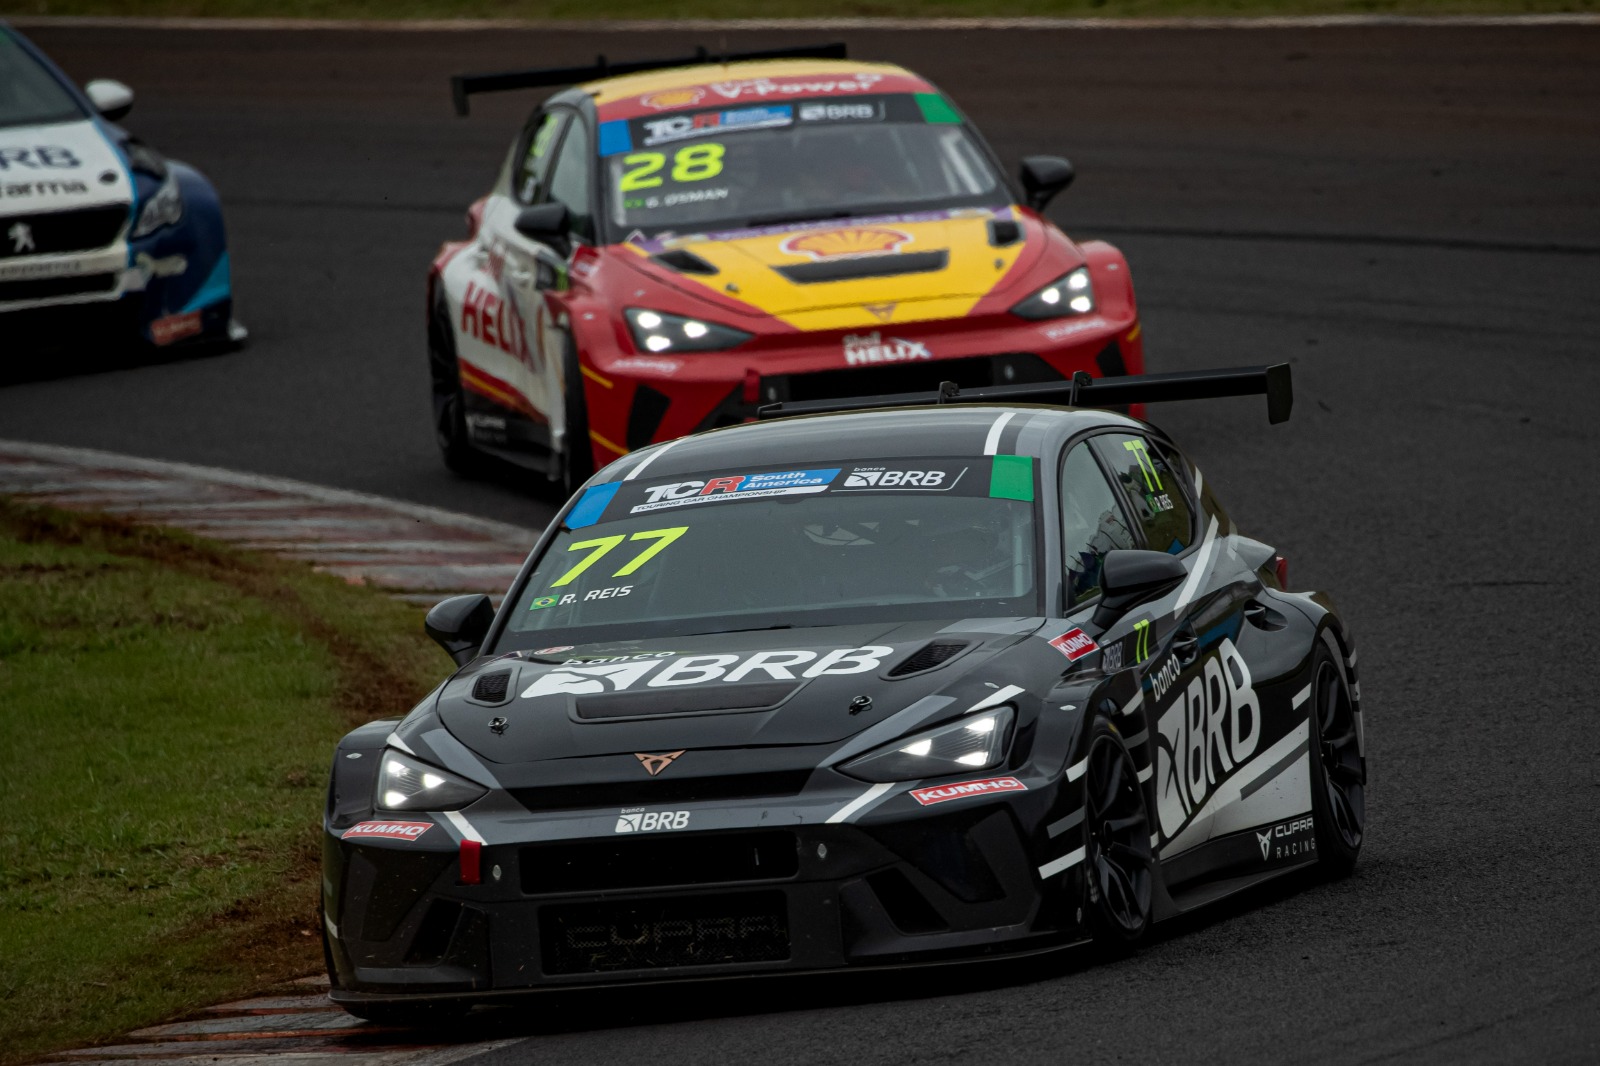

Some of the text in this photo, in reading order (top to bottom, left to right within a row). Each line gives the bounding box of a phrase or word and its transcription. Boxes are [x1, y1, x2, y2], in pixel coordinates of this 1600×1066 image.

[620, 142, 726, 192] 28
[844, 337, 931, 366] HELIX
[751, 471, 806, 481] South
[1122, 439, 1165, 493] 77
[643, 475, 746, 503] TCR
[743, 477, 823, 489] America
[878, 470, 946, 486] BRB
[637, 488, 788, 510] TOURING CAR CHAMPIONSHIP
[550, 526, 690, 588] 77
[558, 585, 634, 605] R. REIS
[1057, 632, 1093, 655] KUMHO
[1133, 619, 1150, 664] 77
[561, 651, 676, 666] banco
[646, 645, 894, 687] BRB
[1149, 653, 1181, 702] banco
[1187, 637, 1261, 805] BRB
[918, 779, 1018, 801] KUMHO
[353, 822, 423, 837] KUMHO
[643, 810, 691, 831] BRB
[1275, 817, 1314, 838] CUPRA
[1276, 837, 1316, 860] RACING
